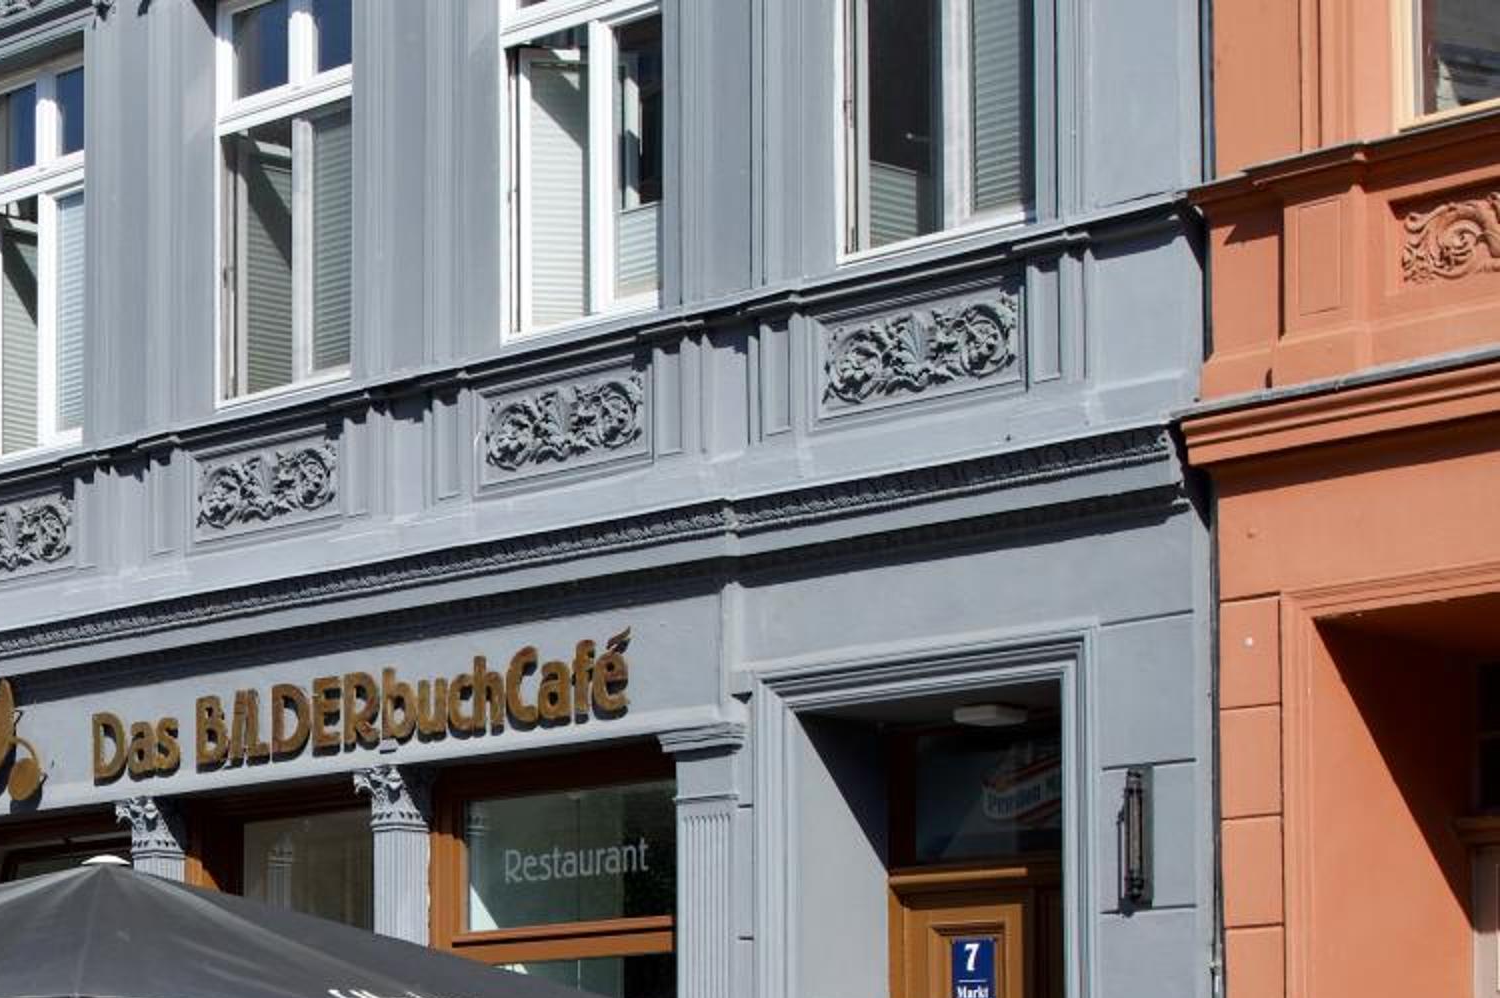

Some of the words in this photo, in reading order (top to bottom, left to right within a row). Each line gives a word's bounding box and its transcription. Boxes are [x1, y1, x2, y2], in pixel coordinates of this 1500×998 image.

[93, 710, 181, 785] Das
[505, 837, 650, 884] Restaurant
[964, 943, 980, 971] 7
[957, 986, 989, 998] Markt
